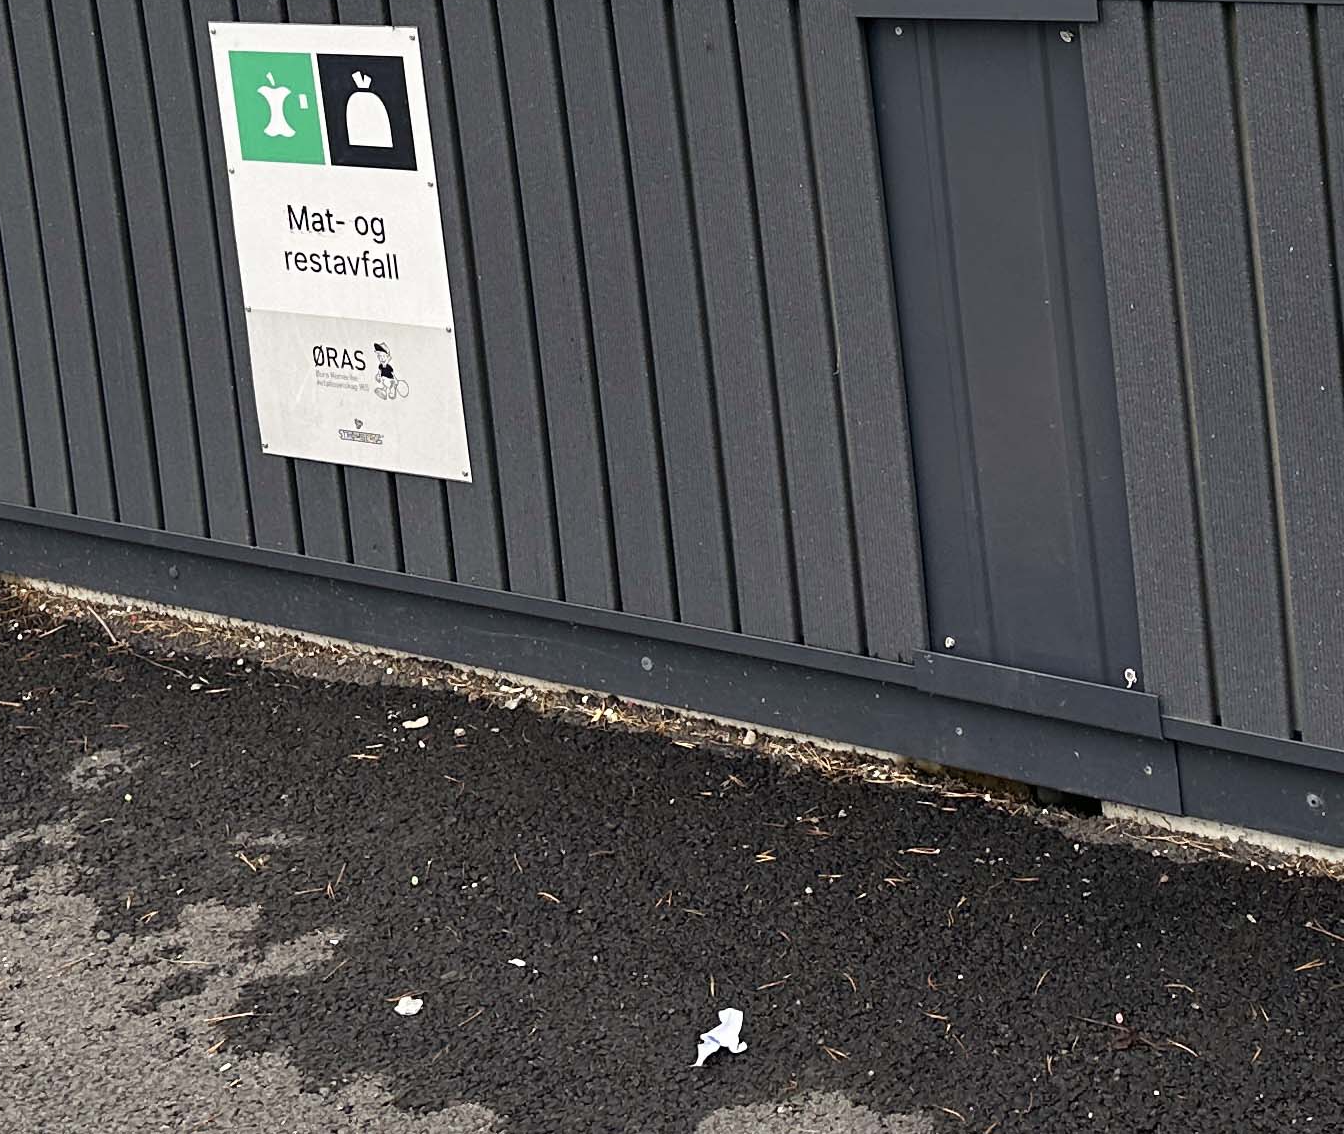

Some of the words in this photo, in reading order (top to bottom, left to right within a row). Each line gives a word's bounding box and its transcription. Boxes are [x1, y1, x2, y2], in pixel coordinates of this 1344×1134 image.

[287, 204, 345, 233] Mat-
[354, 216, 386, 244] og
[284, 250, 399, 280] restavfall
[312, 345, 366, 371] ØRAS
